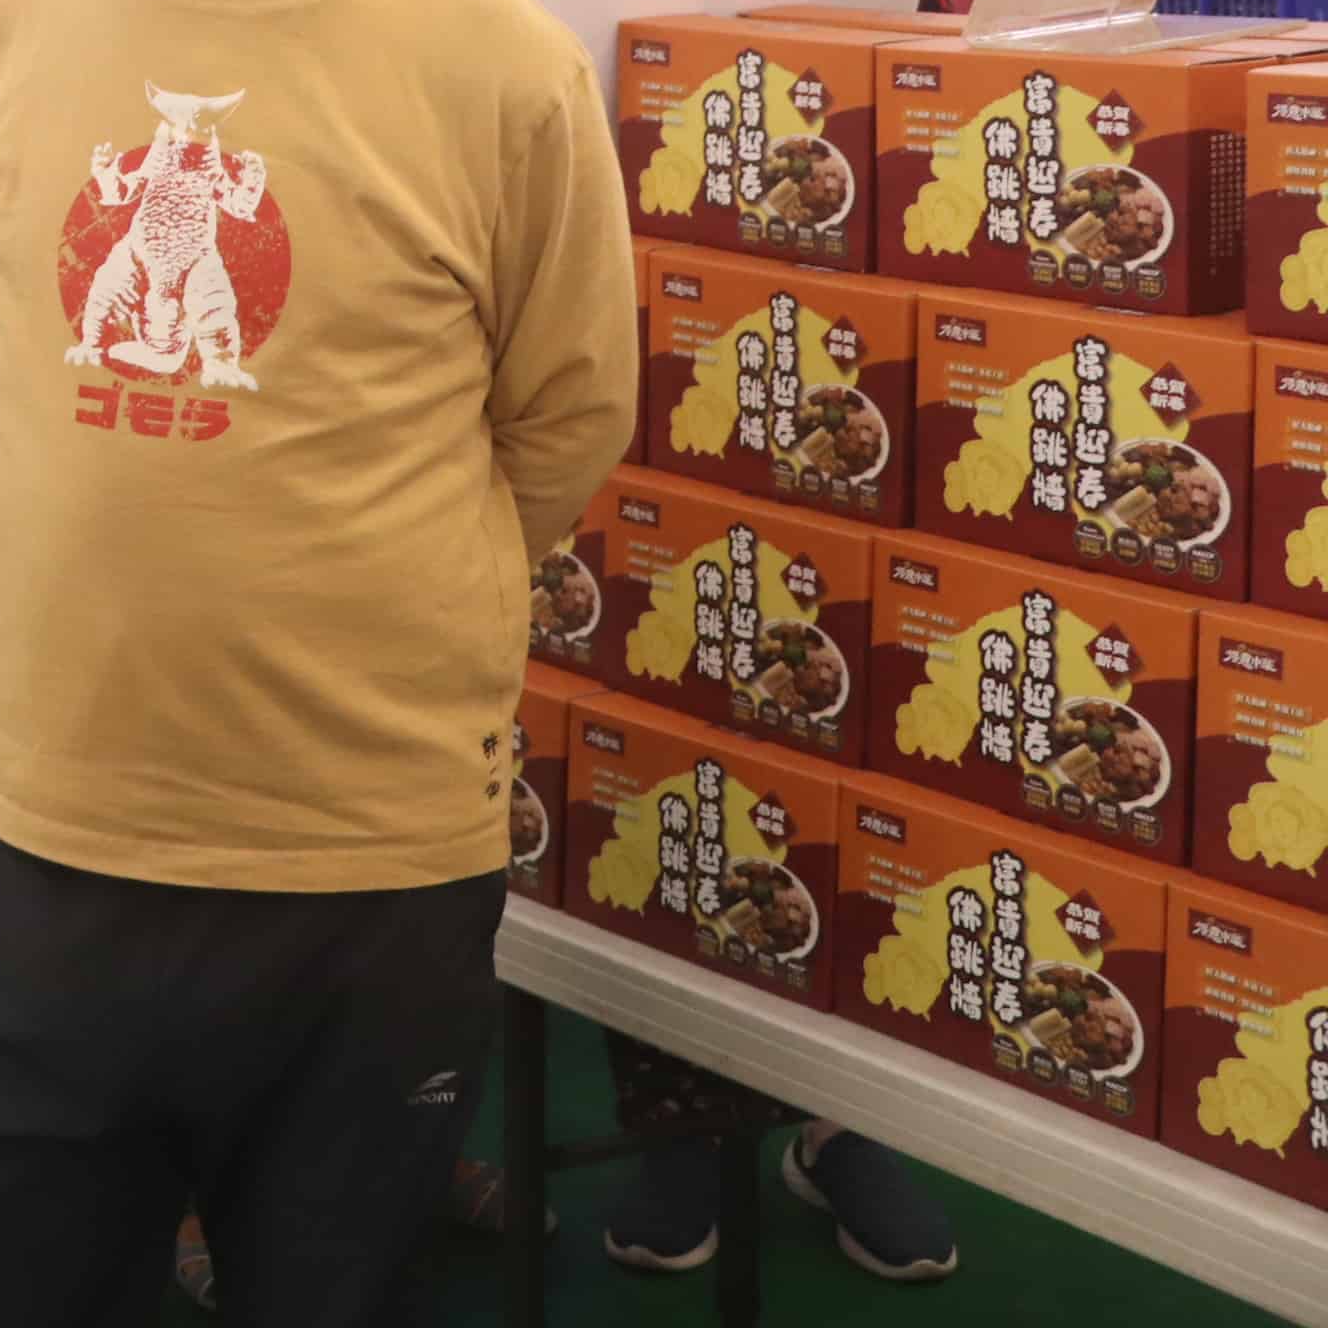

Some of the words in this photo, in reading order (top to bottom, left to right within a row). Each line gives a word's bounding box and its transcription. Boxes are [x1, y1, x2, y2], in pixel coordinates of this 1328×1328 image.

[704, 93, 733, 207] 佛跳牆
[737, 52, 765, 202] 富貴迎春
[985, 121, 1020, 244] 佛跳牆
[1025, 74, 1059, 238] 富貴迎春
[75, 380, 232, 442] ゴモラ
[737, 334, 767, 451] 佛跳牆
[771, 294, 798, 448] 富貴迎春
[1075, 338, 1109, 509] 富貴迎春
[1031, 383, 1068, 512] 佛跳牆
[695, 563, 724, 681] 佛跳牆
[730, 527, 757, 679] 富貴迎春
[980, 633, 1016, 763] 佛跳牆
[1022, 592, 1055, 763] 富貴迎春
[661, 796, 690, 913] 佛跳牆
[696, 761, 723, 915] 富貴迎春
[949, 890, 985, 1021] 佛跳牆
[992, 853, 1025, 1023] 富貴迎春
